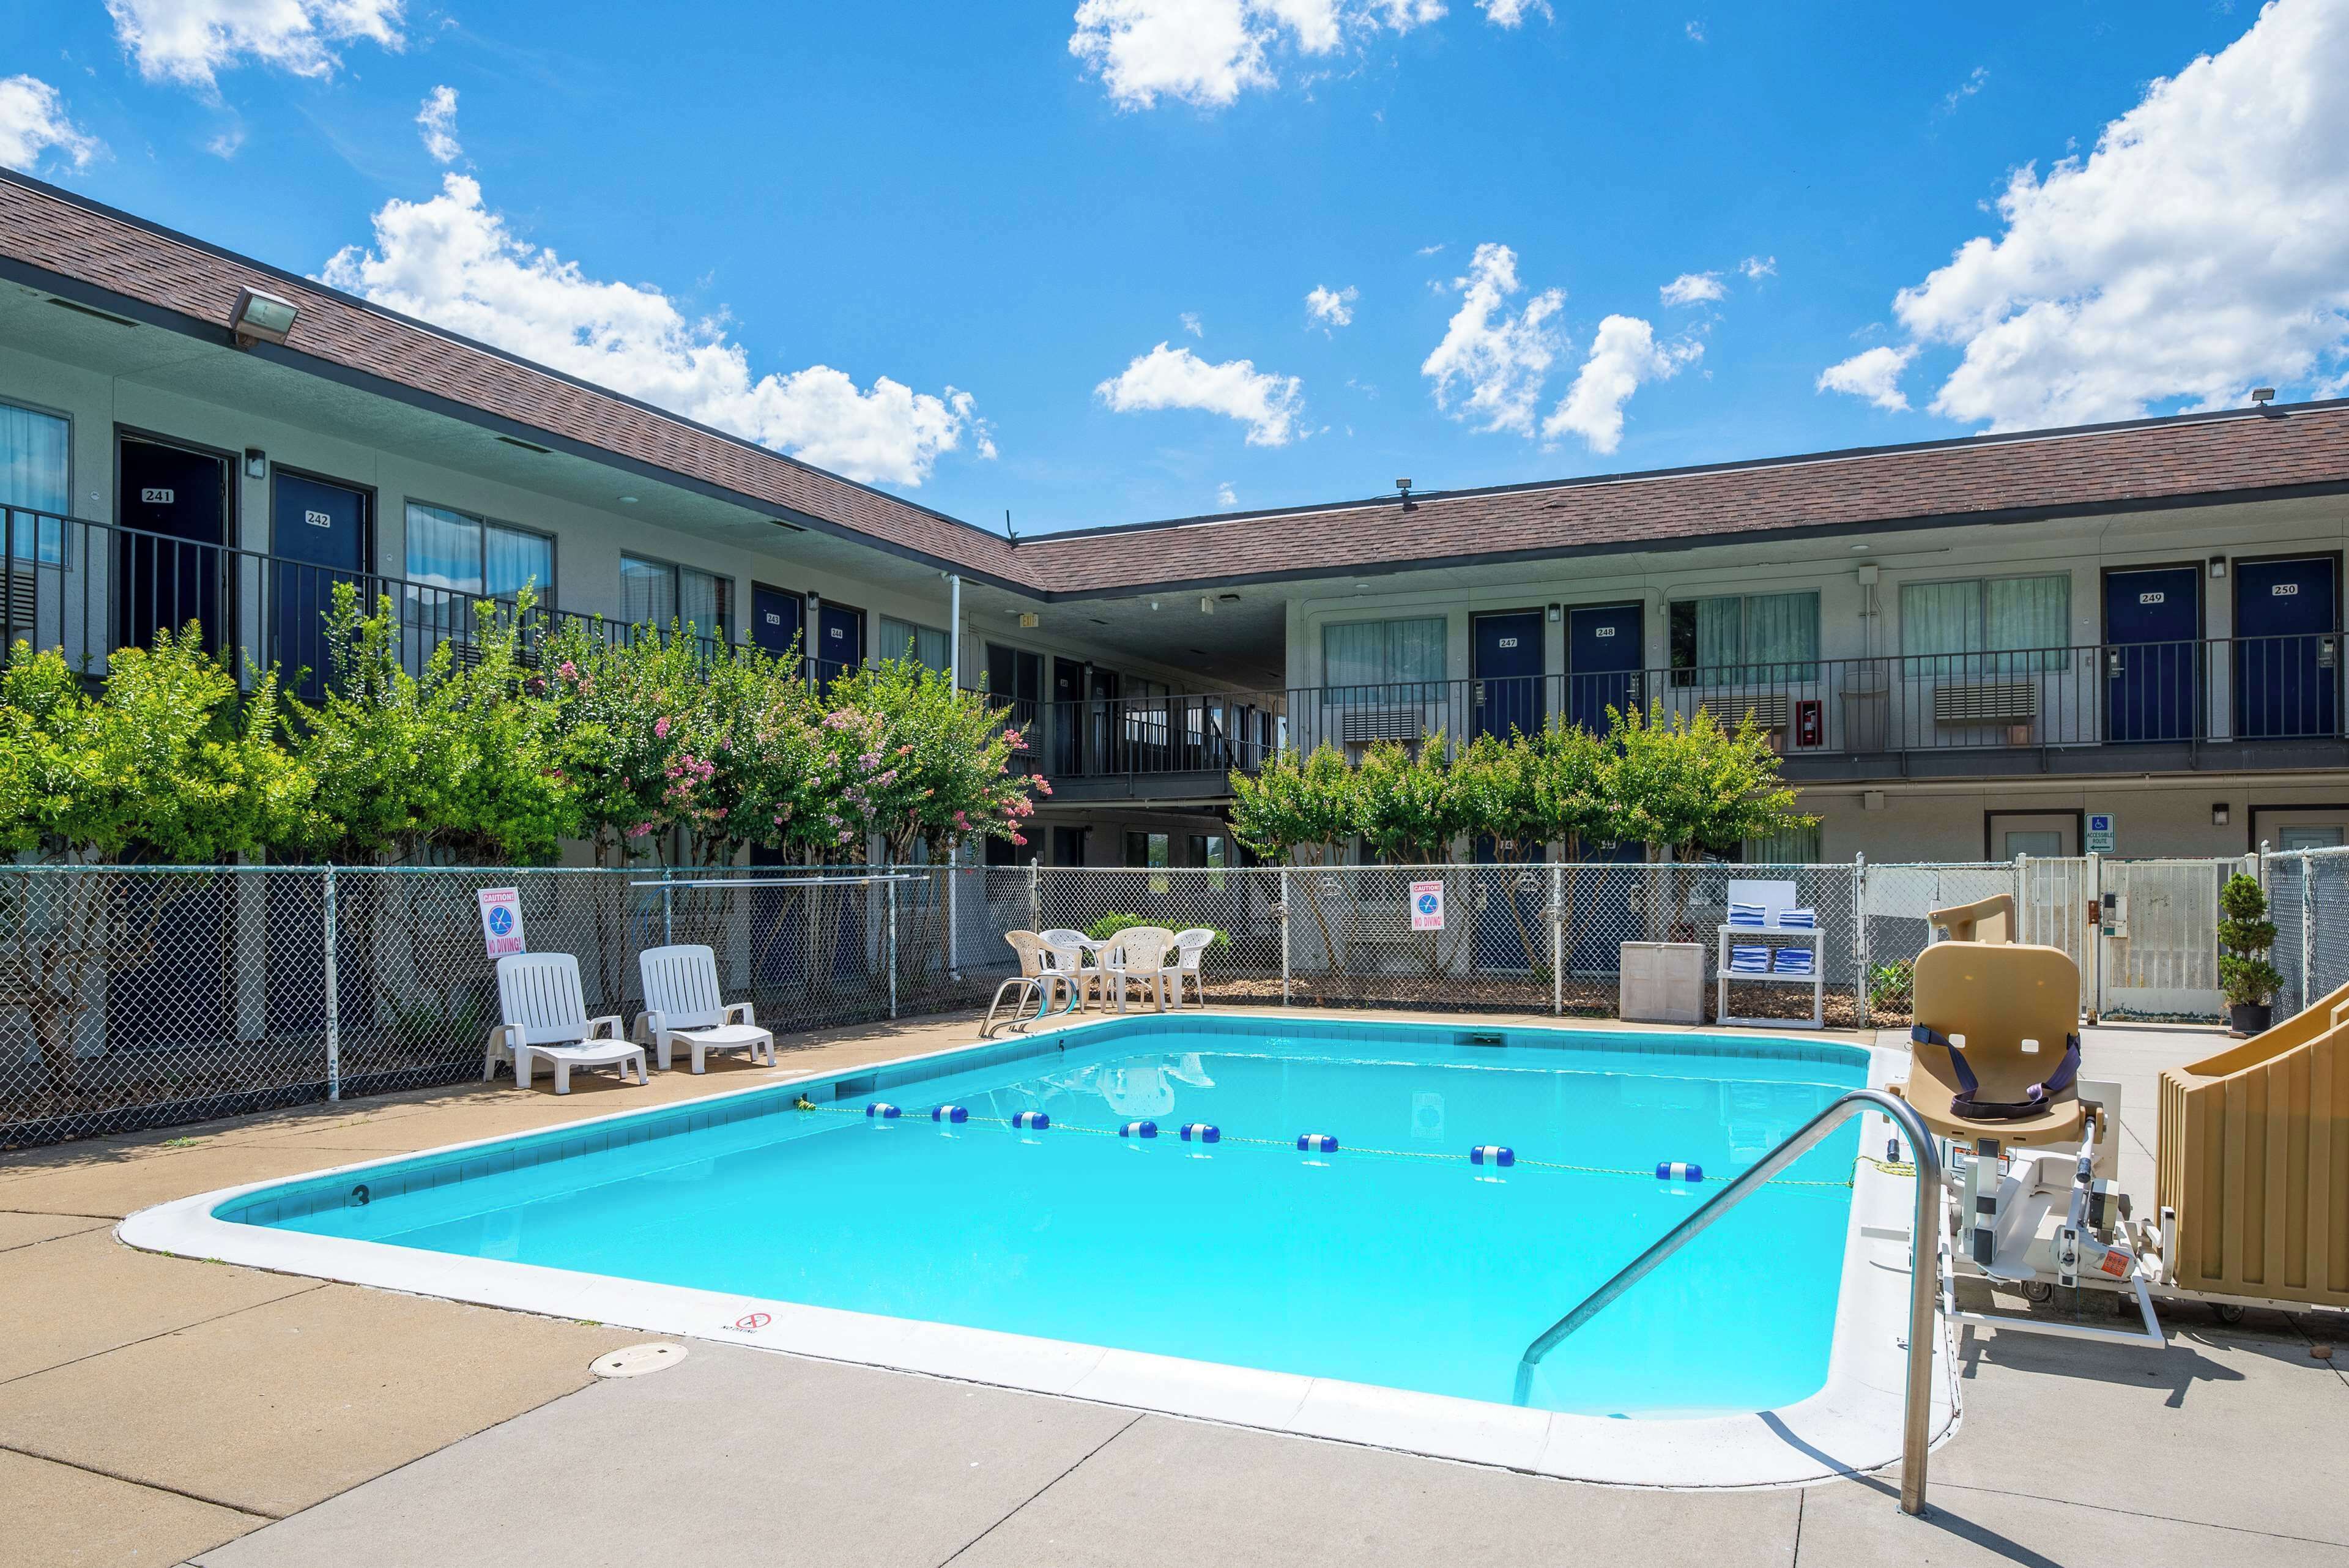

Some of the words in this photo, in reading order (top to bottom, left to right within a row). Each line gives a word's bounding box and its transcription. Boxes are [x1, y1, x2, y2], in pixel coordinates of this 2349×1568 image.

[146, 491, 169, 501] 241
[308, 513, 328, 526] 242
[2274, 585, 2296, 594] 250
[2142, 593, 2162, 603] 249
[768, 615, 779, 623] 243
[1023, 615, 1034, 627] EXIT
[484, 893, 514, 902] CAUTION!
[1414, 917, 1422, 927] NO
[1424, 916, 1442, 927] DIVING!
[488, 939, 495, 954] NO
[497, 937, 522, 953] DIVING!
[1059, 1039, 1064, 1052] 5
